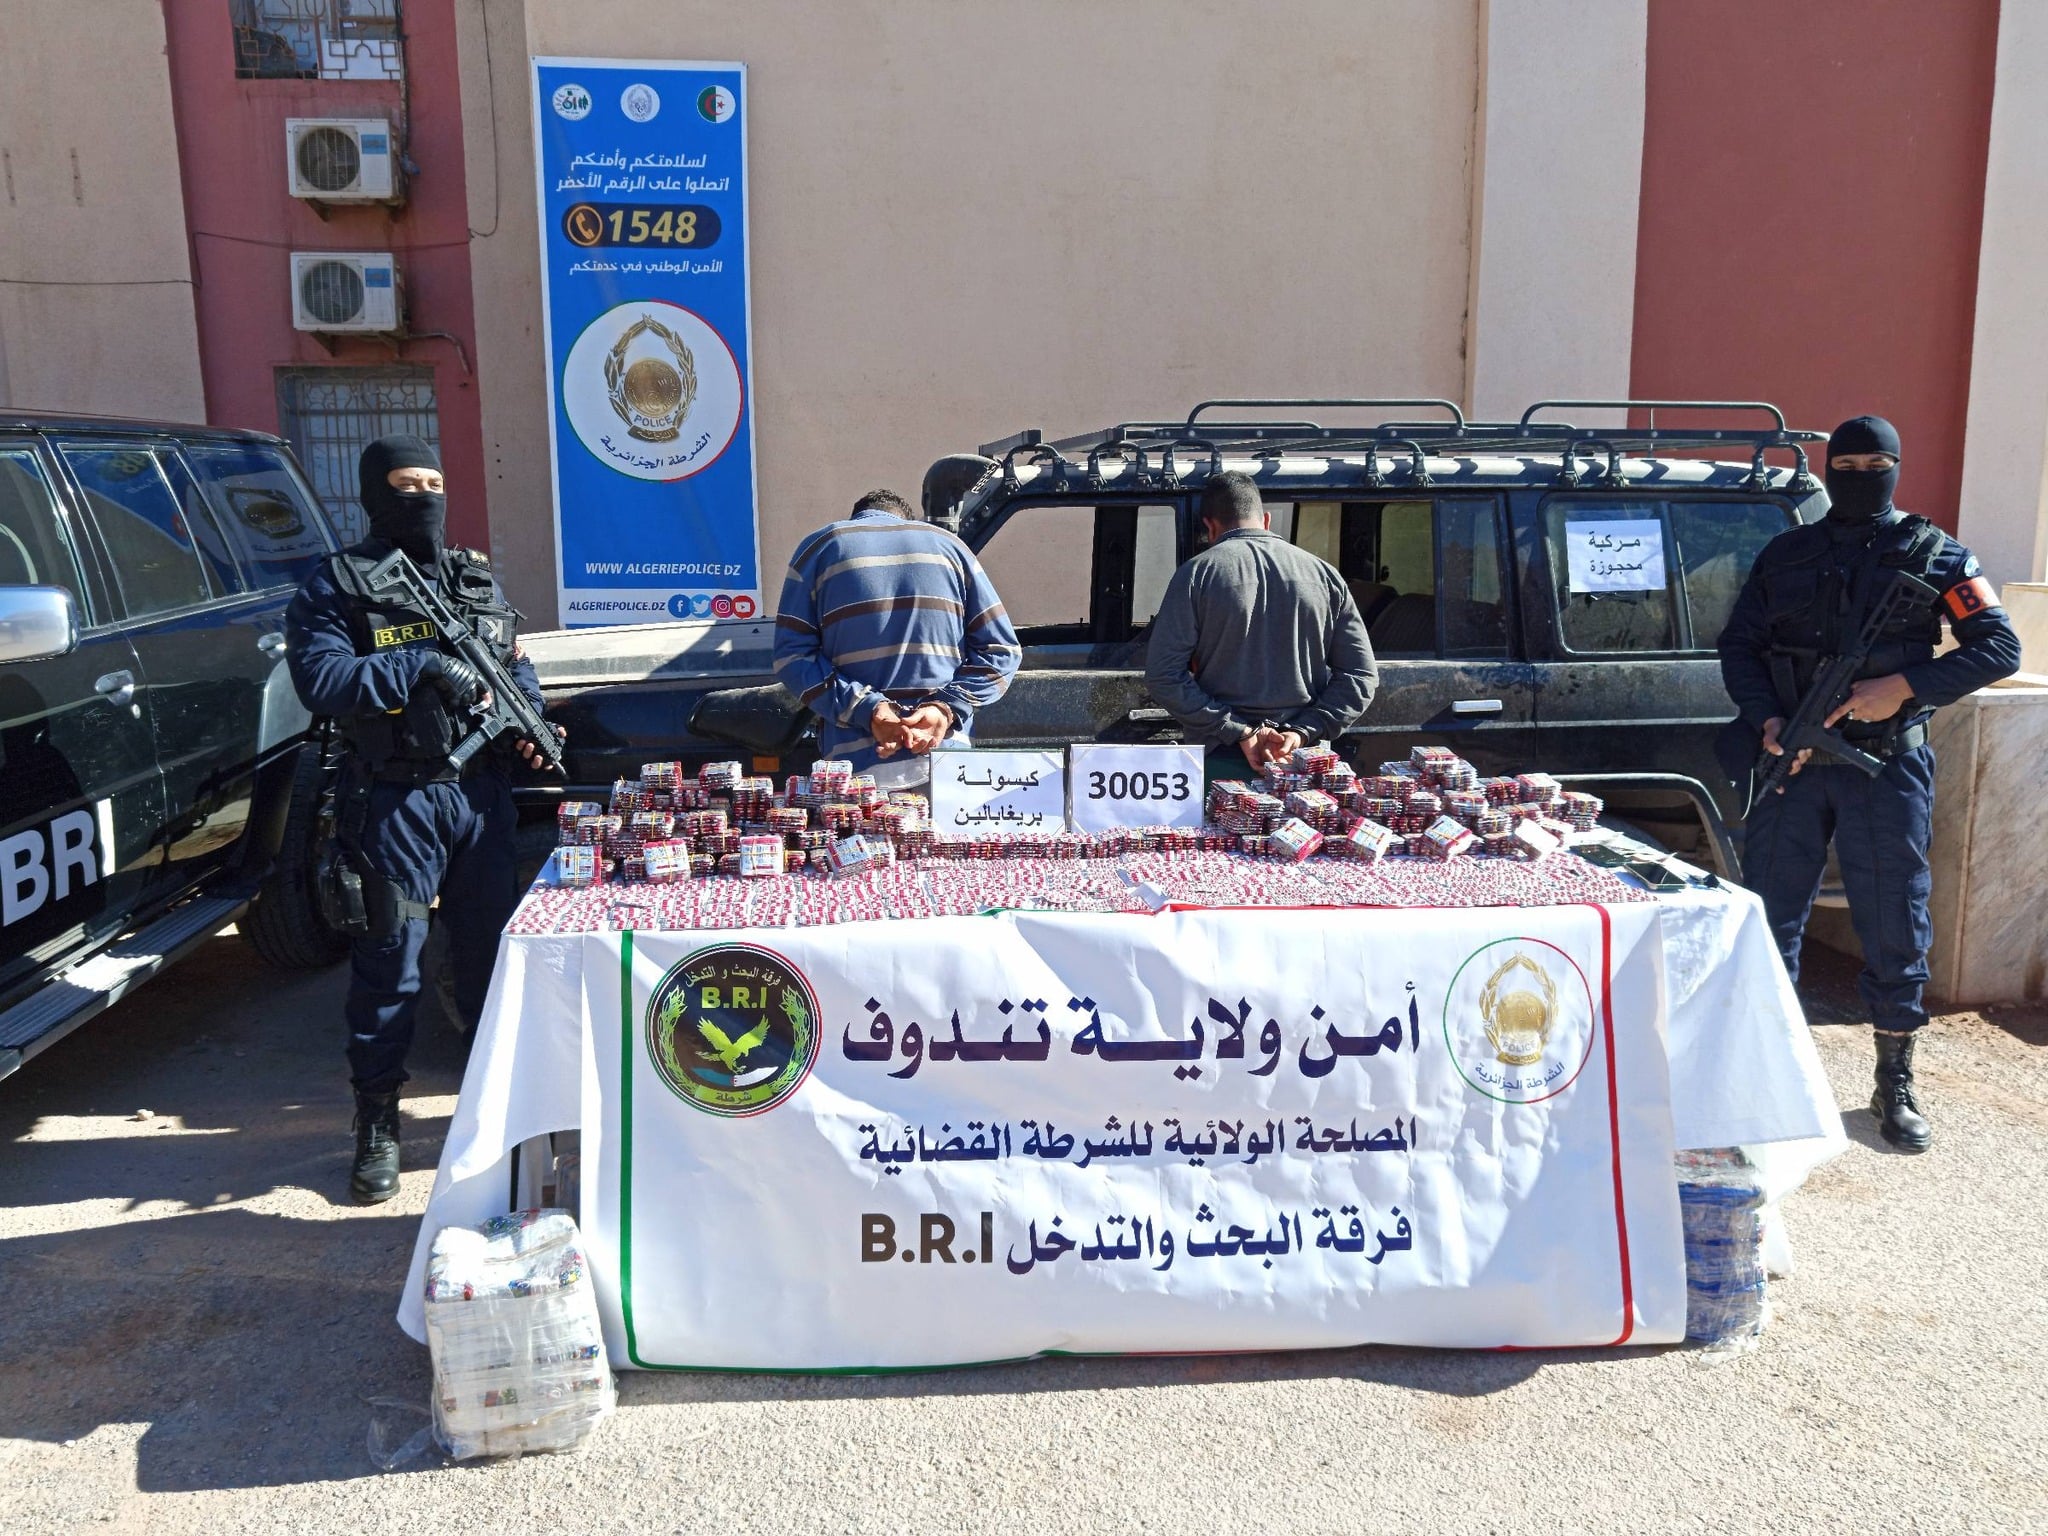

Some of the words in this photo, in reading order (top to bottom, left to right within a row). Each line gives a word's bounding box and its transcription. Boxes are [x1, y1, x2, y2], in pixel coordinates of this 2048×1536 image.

[571, 148, 627, 171] وأمنكم
[629, 153, 707, 172] لسلامتكم
[556, 173, 601, 192] الأخضر
[604, 176, 645, 194] الرقم
[649, 177, 681, 191] على
[685, 177, 730, 193] اتصلوا
[608, 210, 698, 244] 1548
[569, 259, 618, 275] خدمتكم
[620, 261, 644, 273] في
[645, 260, 689, 274] الوطني
[691, 259, 722, 273] الأمن
[633, 414, 673, 428] POLICE
[600, 434, 664, 469] الجزائرية
[668, 432, 711, 466] الشرطة
[1588, 530, 1641, 552] مركبة
[1590, 559, 1643, 575] محجوزة
[568, 601, 665, 611] ALGERIEPOLICE.DZ
[380, 623, 430, 644] B.R.I
[956, 765, 1039, 792] كبسولة
[1088, 771, 1190, 801] 30053
[954, 803, 1043, 825] بريغابالين
[0, 798, 116, 927] BRI
[684, 965, 716, 987] التدخل
[731, 963, 760, 979] البحث
[761, 967, 782, 987] فرقة
[701, 986, 767, 1009] B.R.I
[842, 996, 1051, 1079] تندوف
[1070, 996, 1283, 1081] ولاية
[1298, 980, 1421, 1078] أمن
[1475, 1062, 1522, 1093] الجزائرية
[1527, 1061, 1565, 1089] الشرطة
[715, 1089, 753, 1103] شرطة
[1021, 1115, 1154, 1168] للشرطة
[1164, 1118, 1285, 1167] الولائية
[1294, 1115, 1417, 1155] المصلحة
[858, 1121, 1012, 1174] القضائية
[861, 1211, 993, 1264] B.R.I
[1006, 1213, 1174, 1275] والتدخل
[1185, 1202, 1303, 1269] البحث
[1311, 1206, 1412, 1264] فرقة
